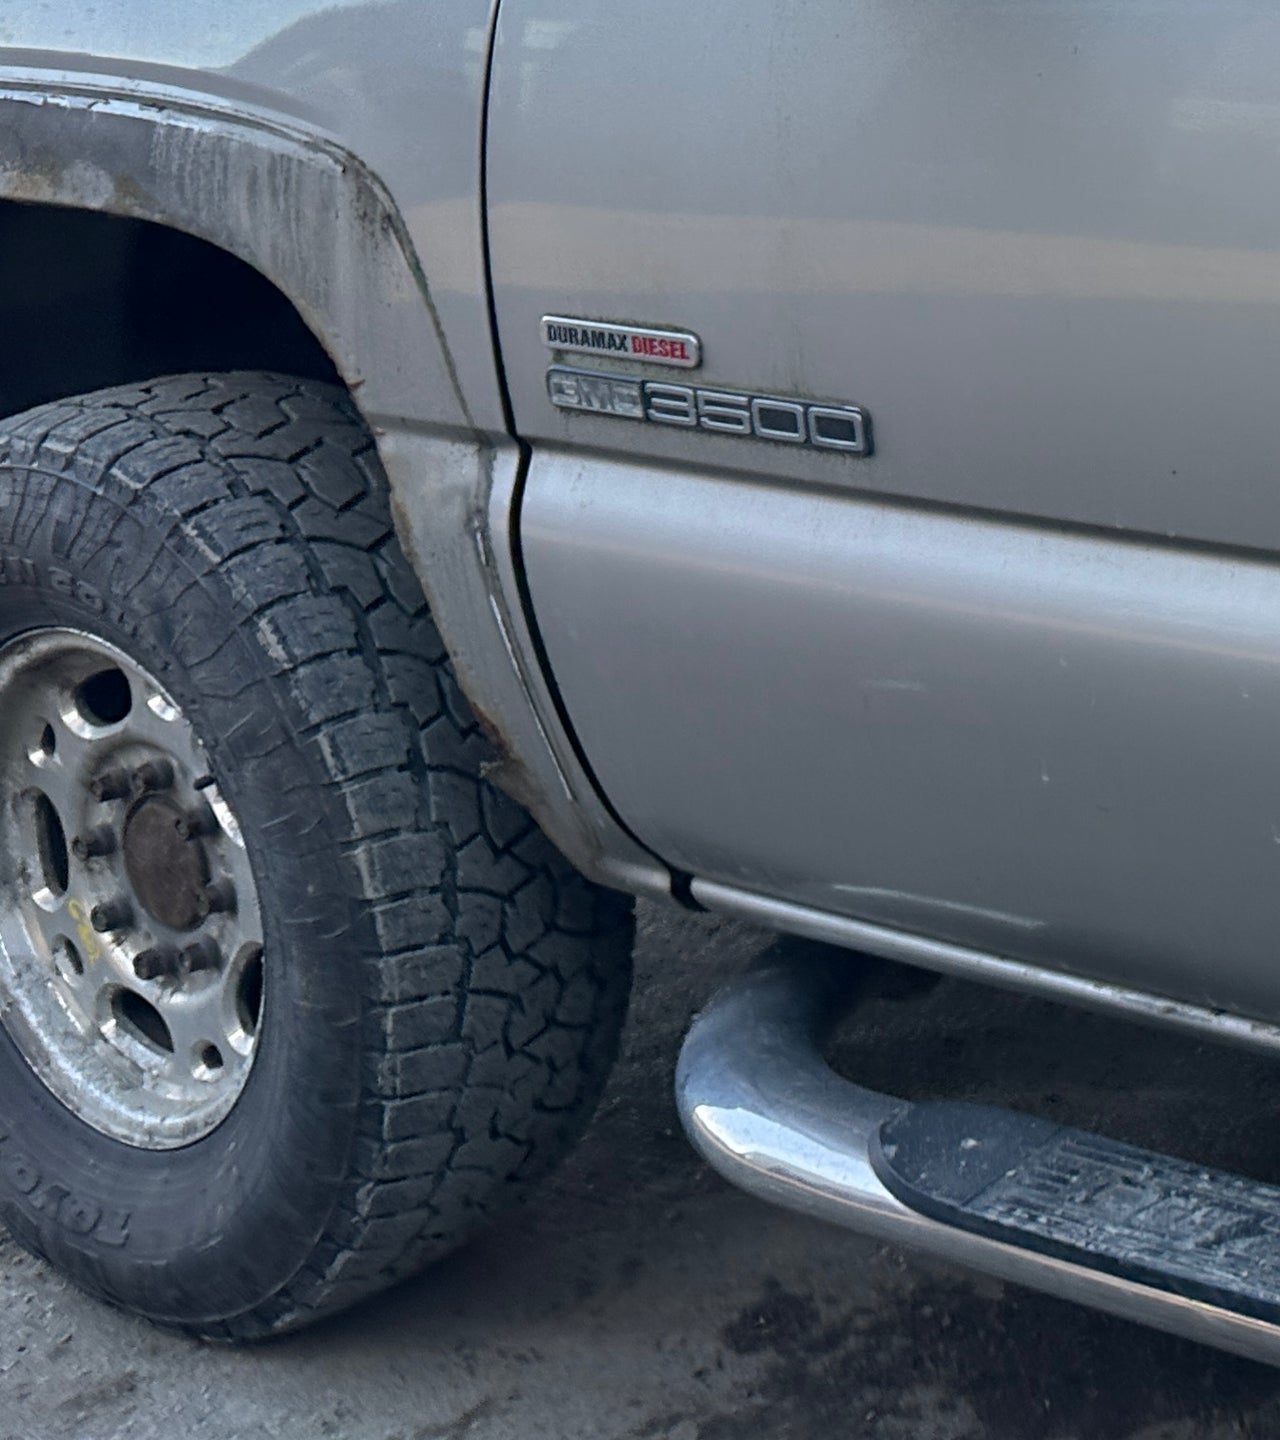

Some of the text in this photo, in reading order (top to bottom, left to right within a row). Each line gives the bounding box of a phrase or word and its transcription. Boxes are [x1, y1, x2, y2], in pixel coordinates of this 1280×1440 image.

[547, 323, 691, 361] DURAMAX DIESEL
[551, 372, 865, 453] GMC 3500
